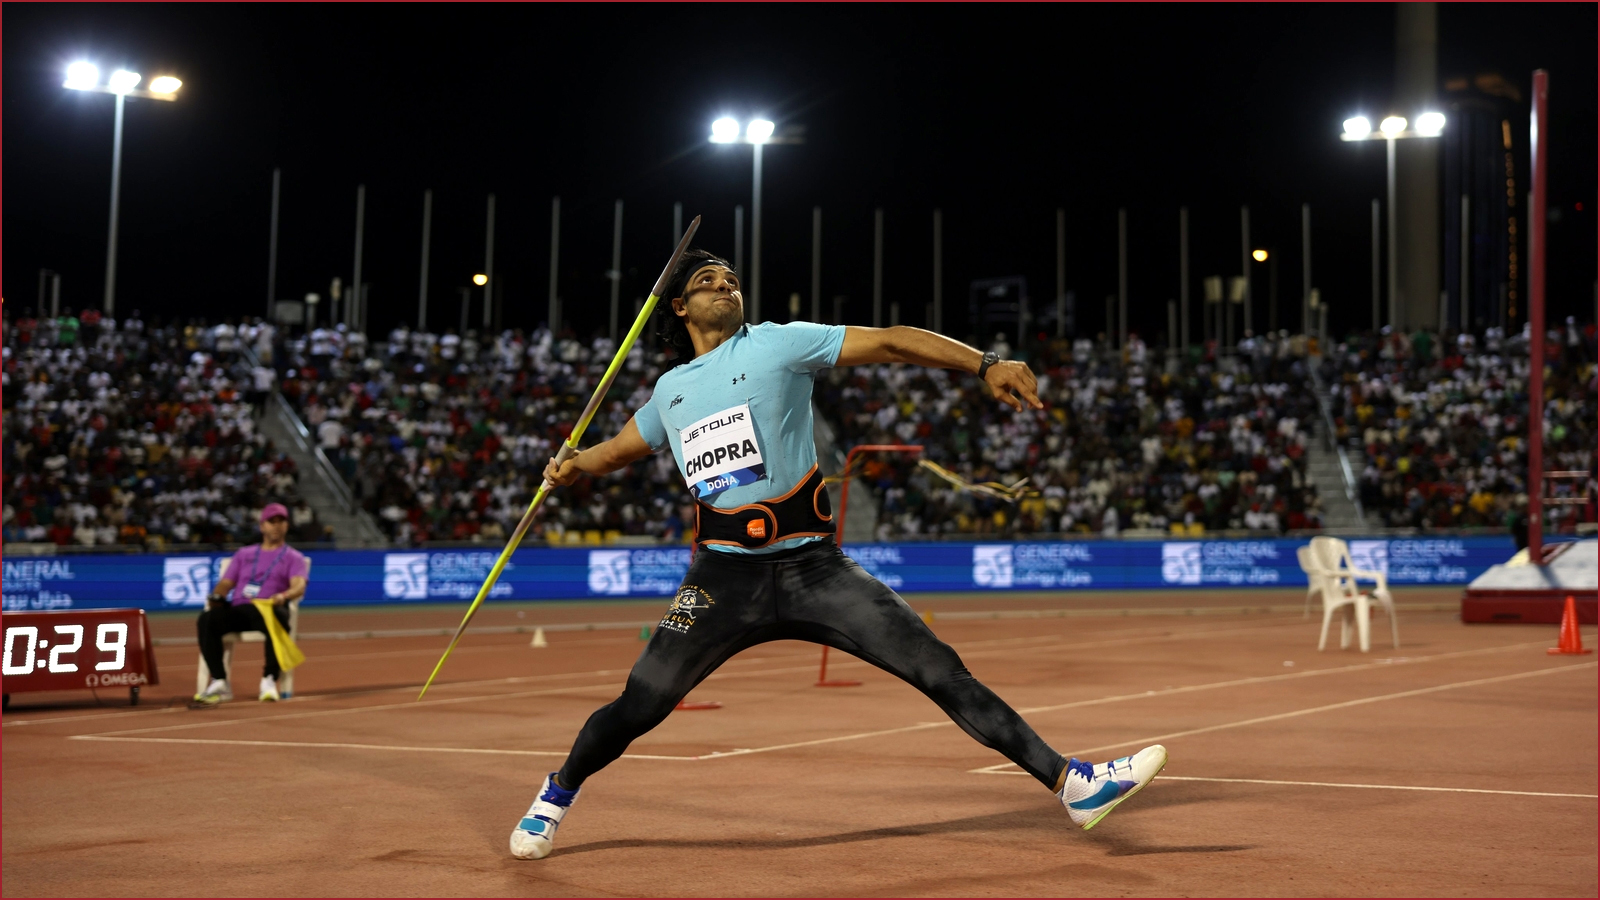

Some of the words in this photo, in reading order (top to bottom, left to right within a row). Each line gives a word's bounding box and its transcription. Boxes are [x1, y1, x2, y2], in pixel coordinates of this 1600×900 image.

[684, 412, 744, 444] JETOUR
[686, 438, 758, 478] CHOPRA
[707, 475, 738, 491] DOHA
[1014, 544, 1093, 561] GENERAL
[1203, 541, 1280, 559] GENERAL
[1390, 540, 1467, 557] GENERAL
[671, 614, 695, 626] RUN
[101, 673, 148, 686] OMEGA
